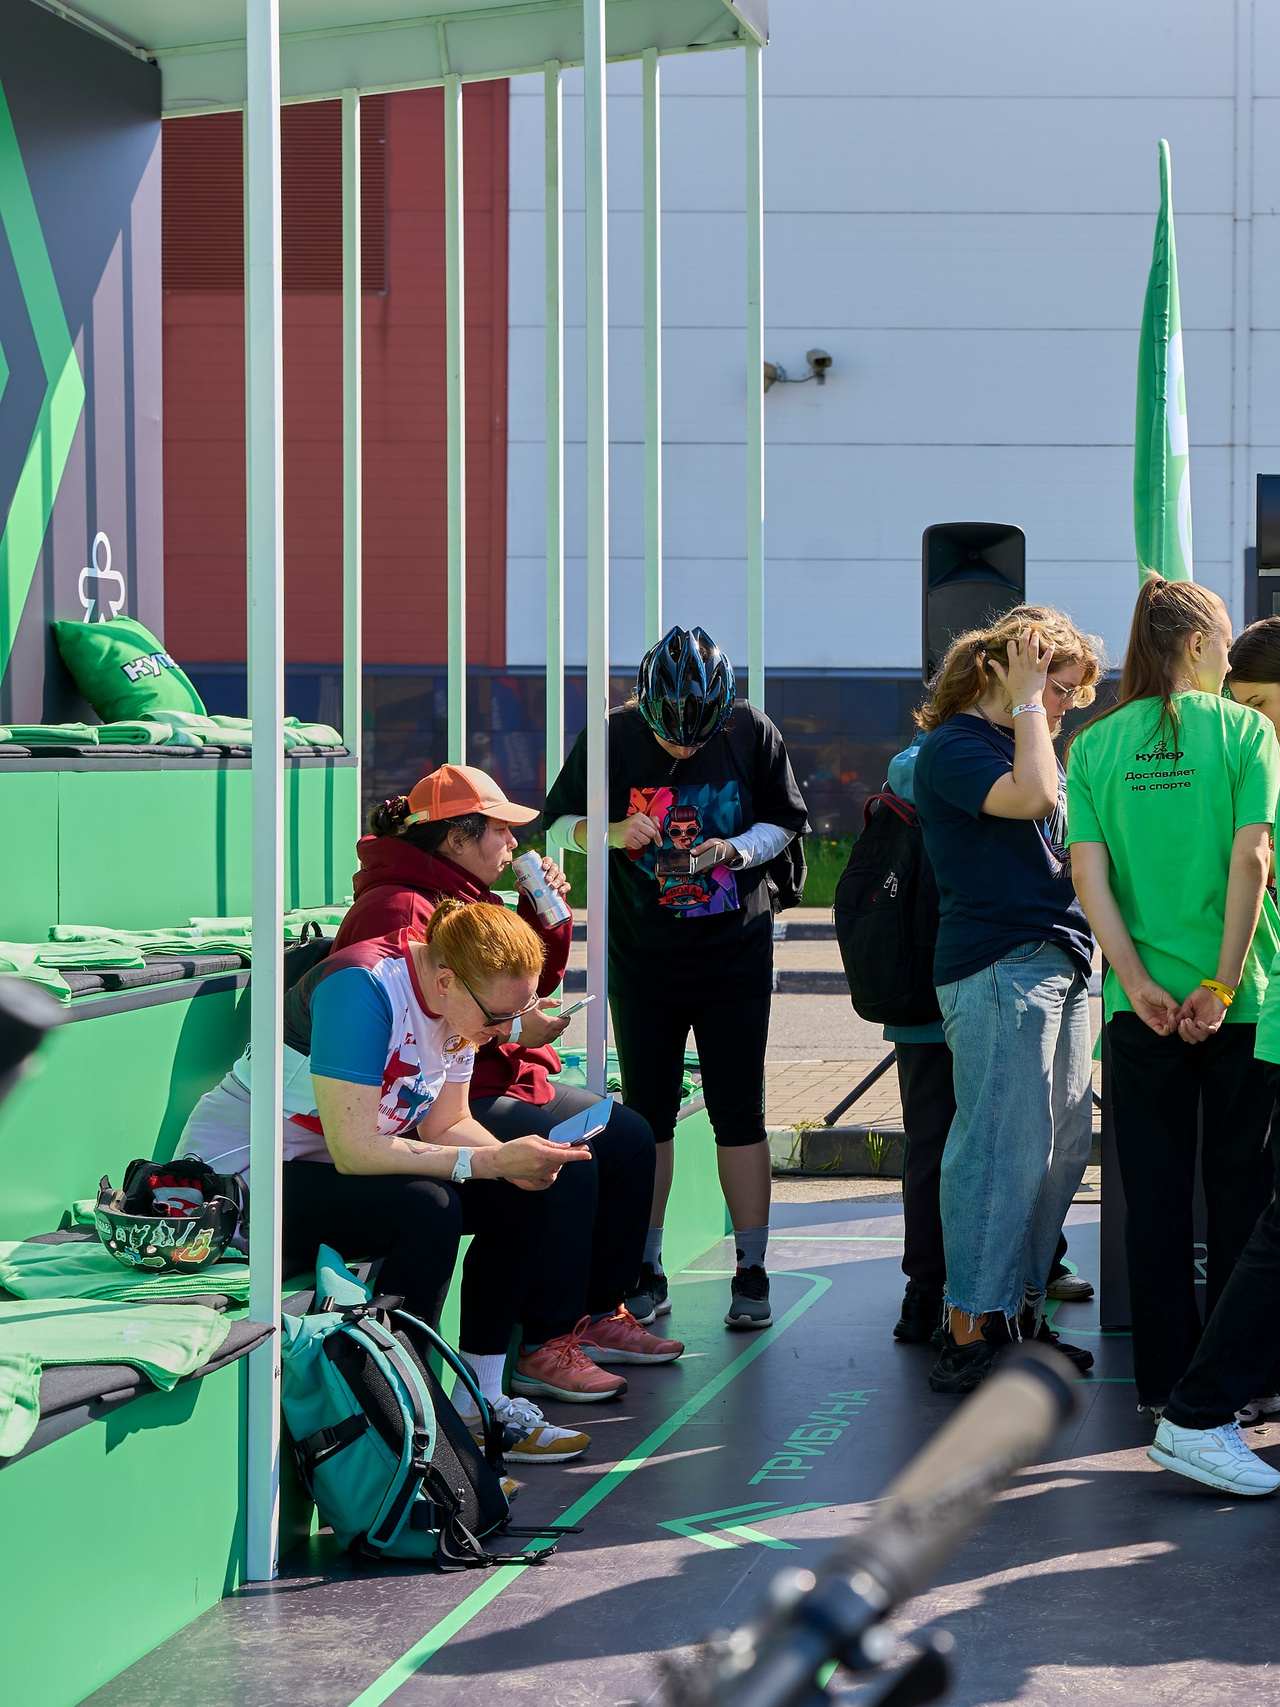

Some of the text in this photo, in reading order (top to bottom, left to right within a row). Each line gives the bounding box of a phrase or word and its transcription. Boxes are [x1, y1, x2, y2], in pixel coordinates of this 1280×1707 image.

[1135, 751, 1184, 763] купер
[1124, 768, 1197, 781] Доставляет
[1149, 781, 1191, 791] спорте
[670, 886, 698, 896] BONA
[747, 1388, 879, 1485] ТРИБУНА
